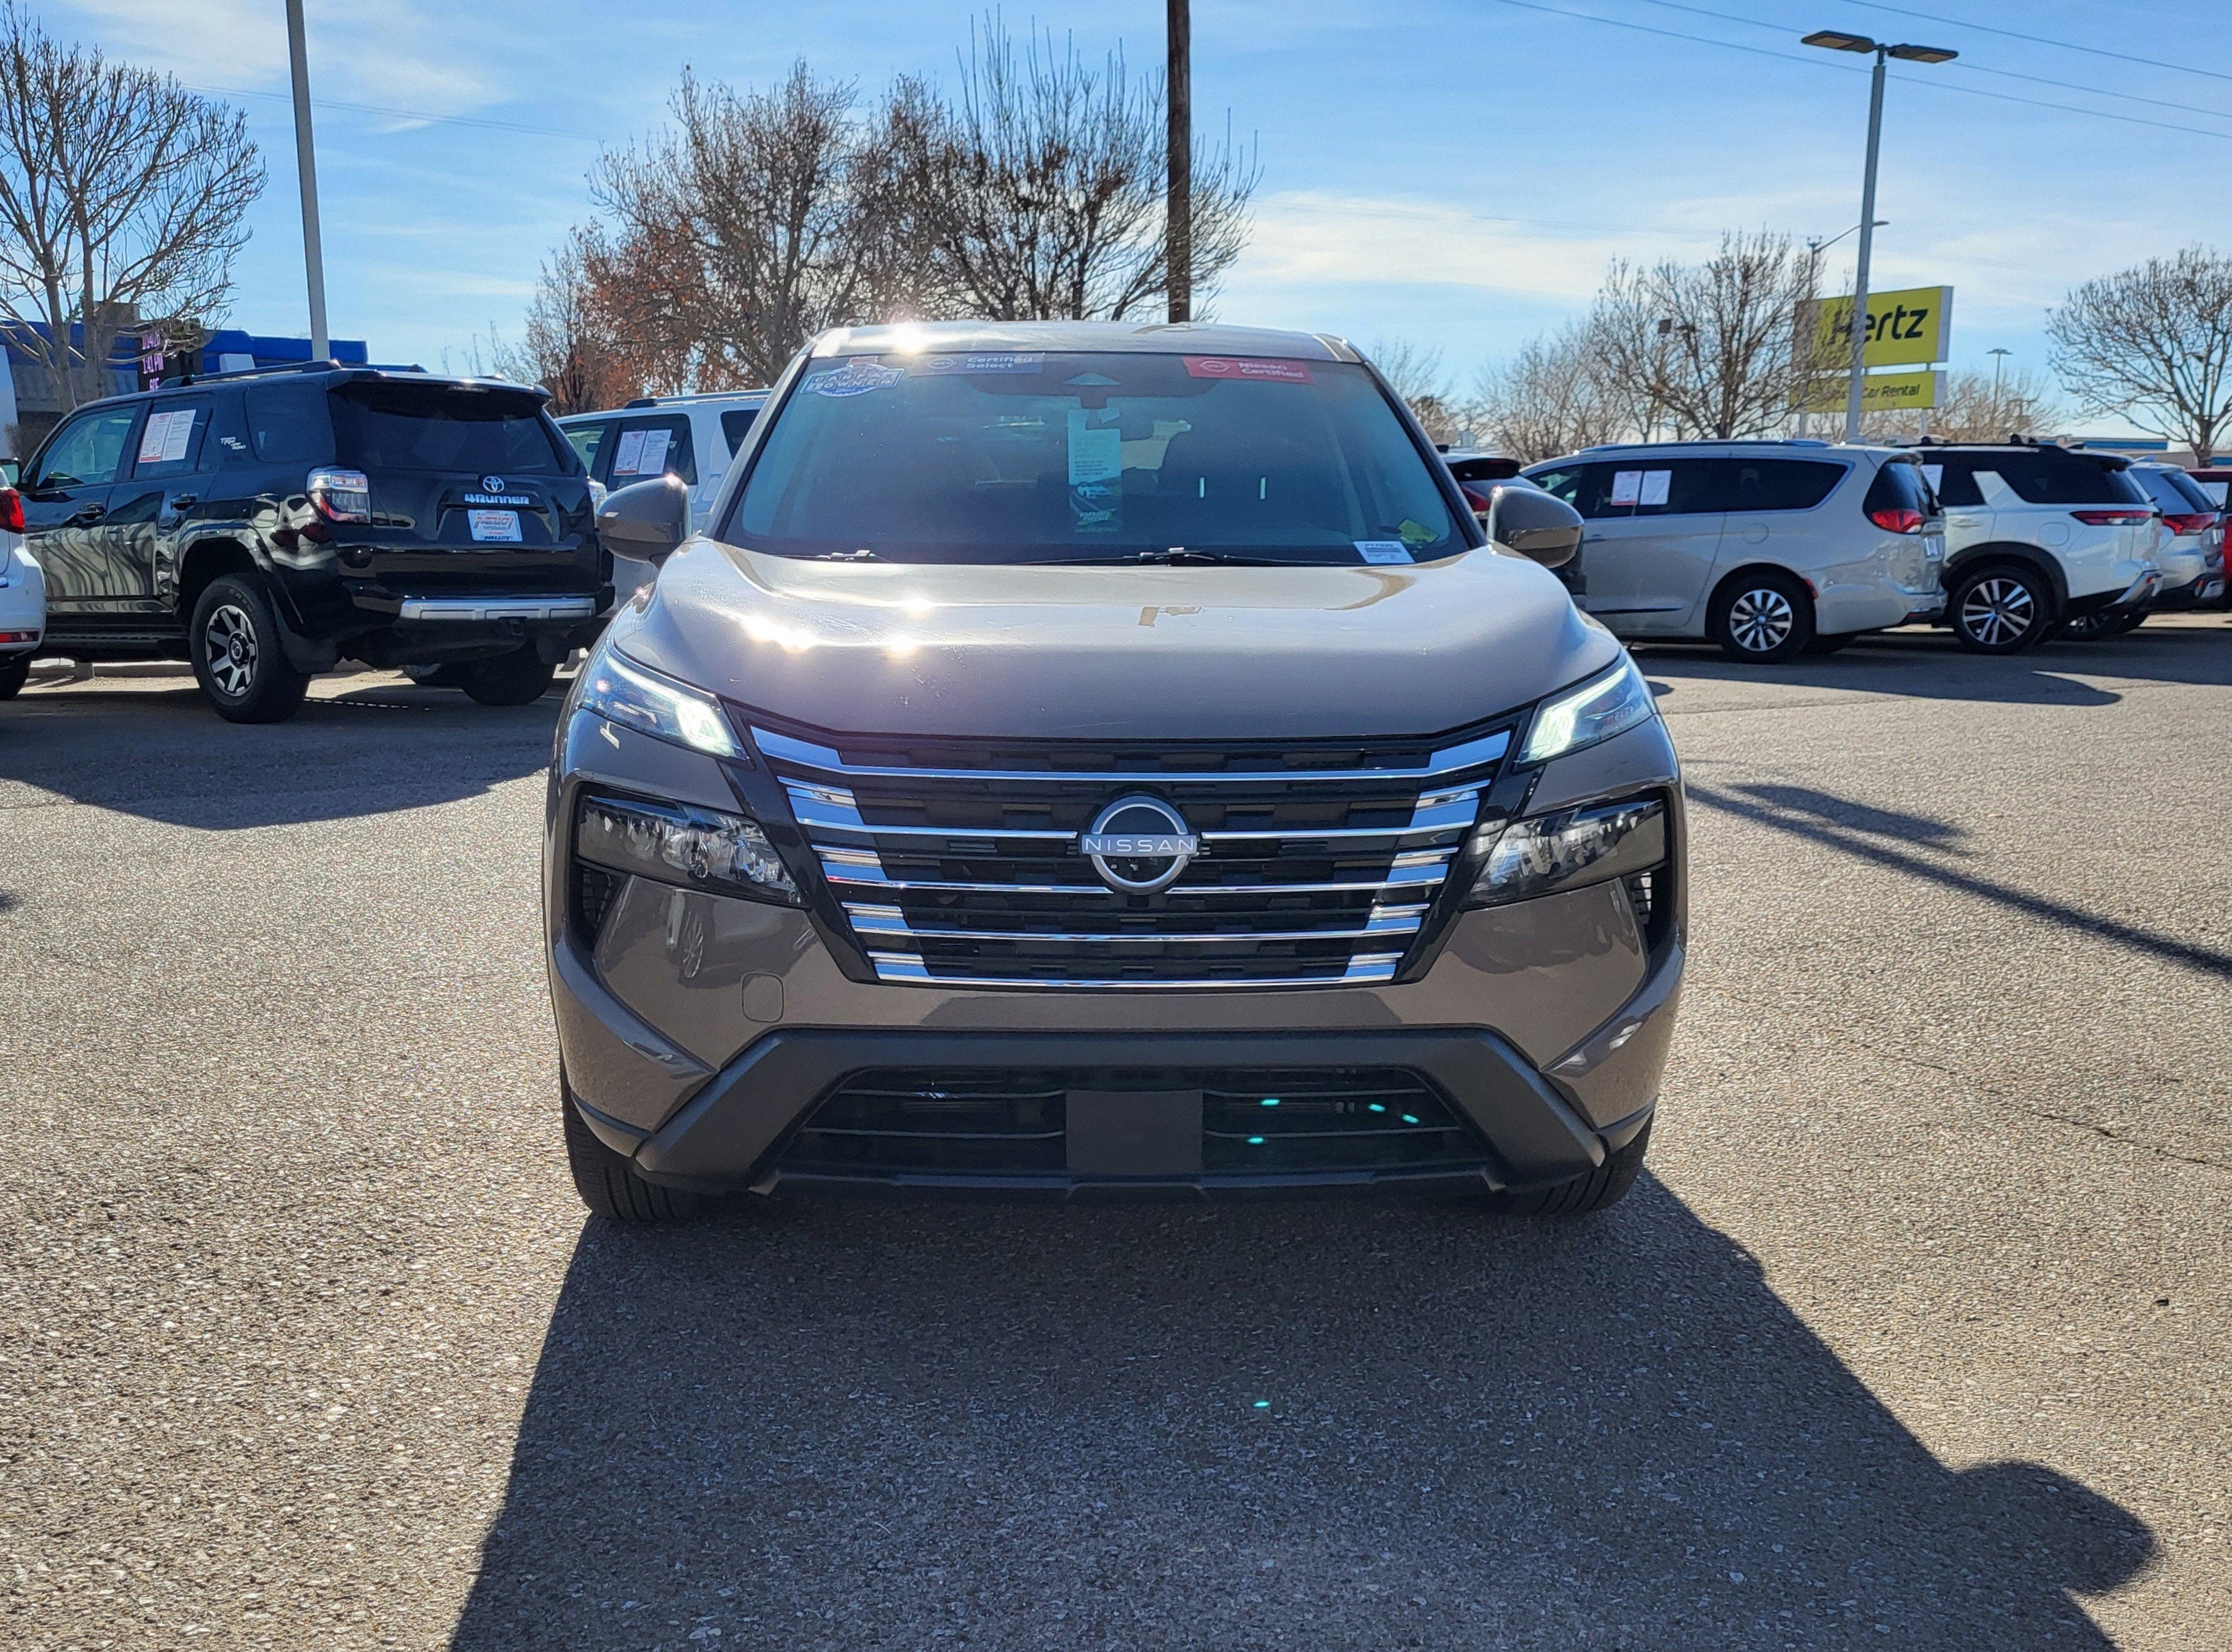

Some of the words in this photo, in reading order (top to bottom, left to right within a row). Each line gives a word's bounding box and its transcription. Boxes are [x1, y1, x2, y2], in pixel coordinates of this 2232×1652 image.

[1826, 304, 1928, 346] Hertz
[1242, 368, 1304, 378] Certified
[1881, 383, 1921, 398] Rental
[1085, 838, 1194, 852] NISSAN
